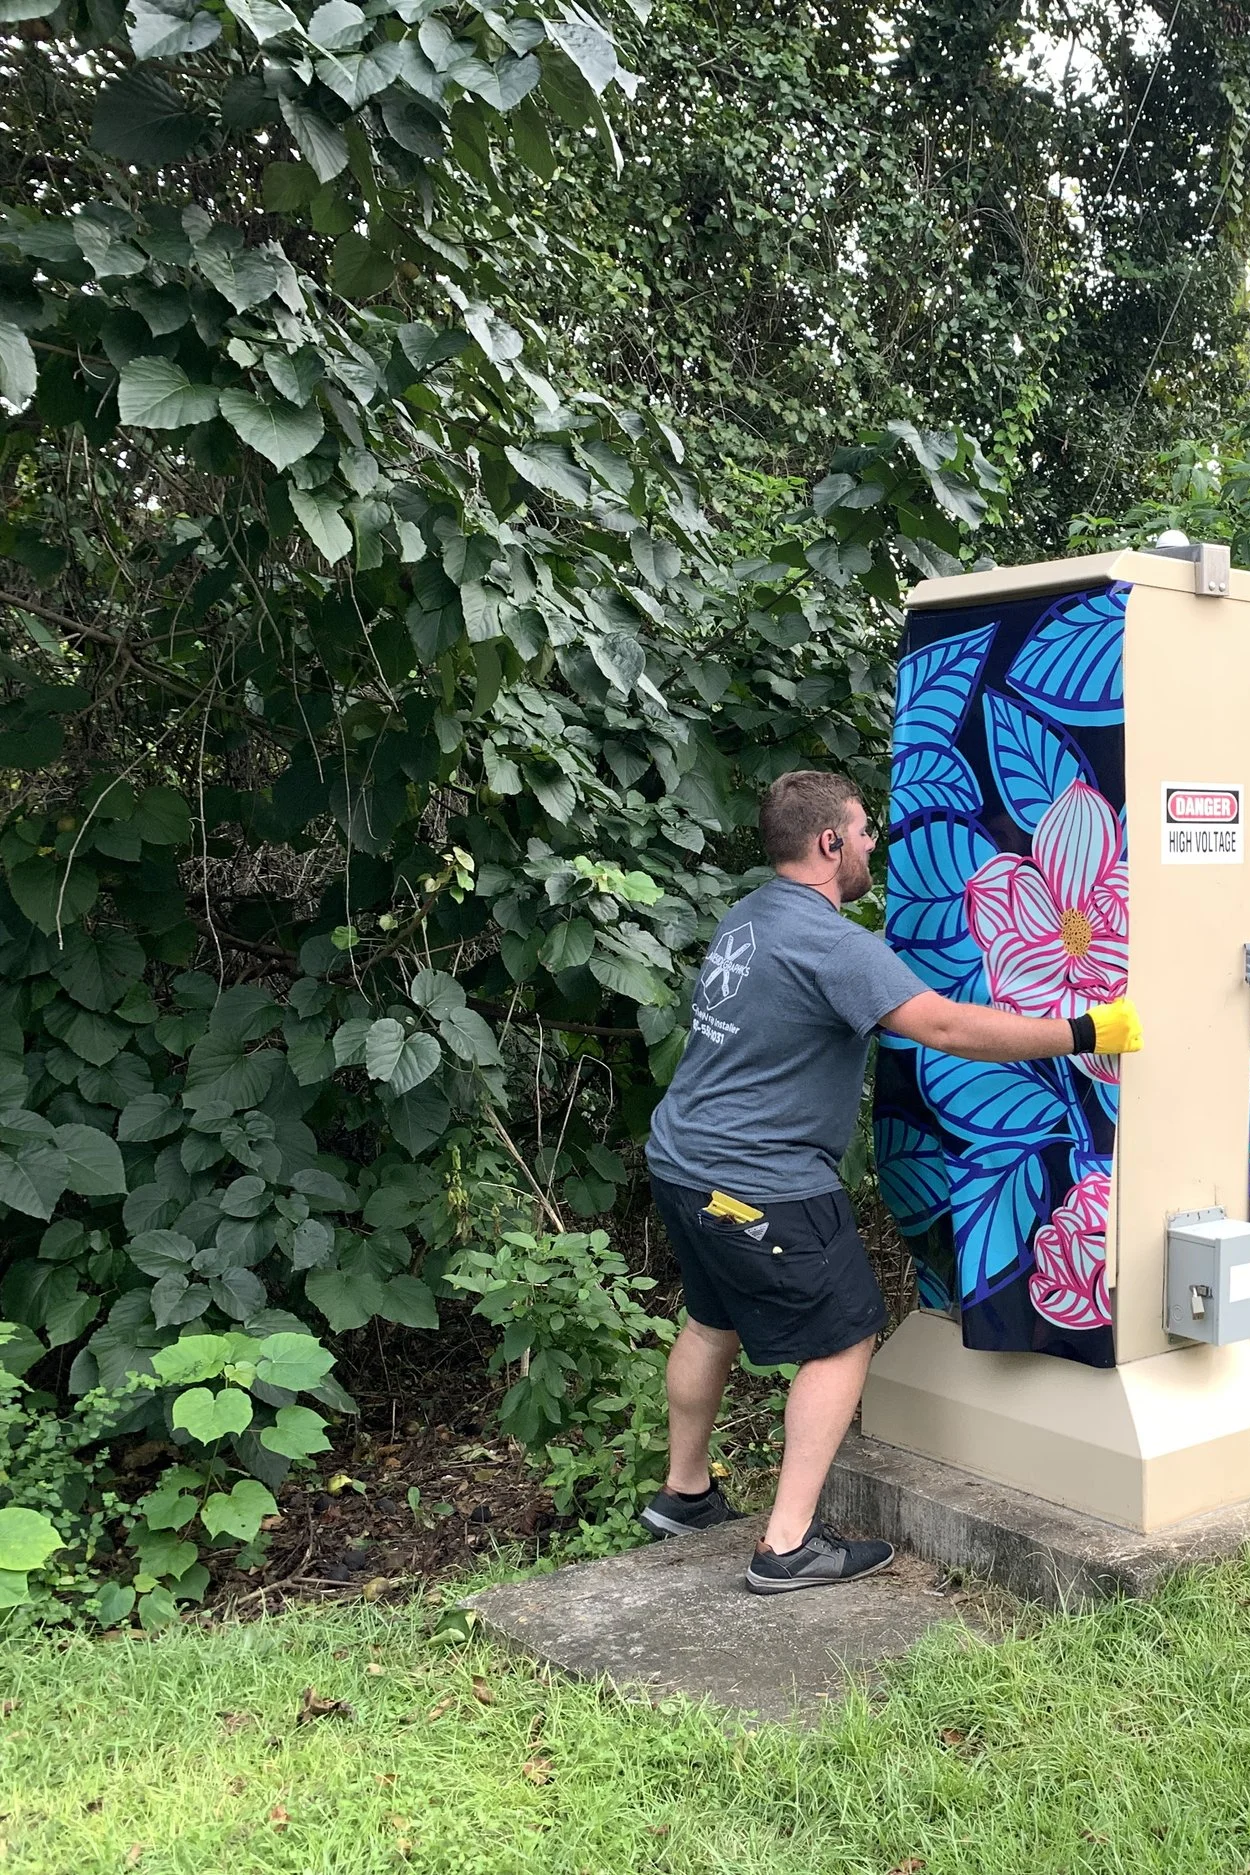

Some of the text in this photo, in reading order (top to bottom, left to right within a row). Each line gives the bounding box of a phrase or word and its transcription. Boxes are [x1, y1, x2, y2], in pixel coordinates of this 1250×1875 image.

[1175, 797, 1231, 817] DANGER
[1169, 831, 1236, 853] HIGH VOLTAGE
[723, 960, 750, 977] GRAPHICS
[714, 1018, 740, 1035] Installer
